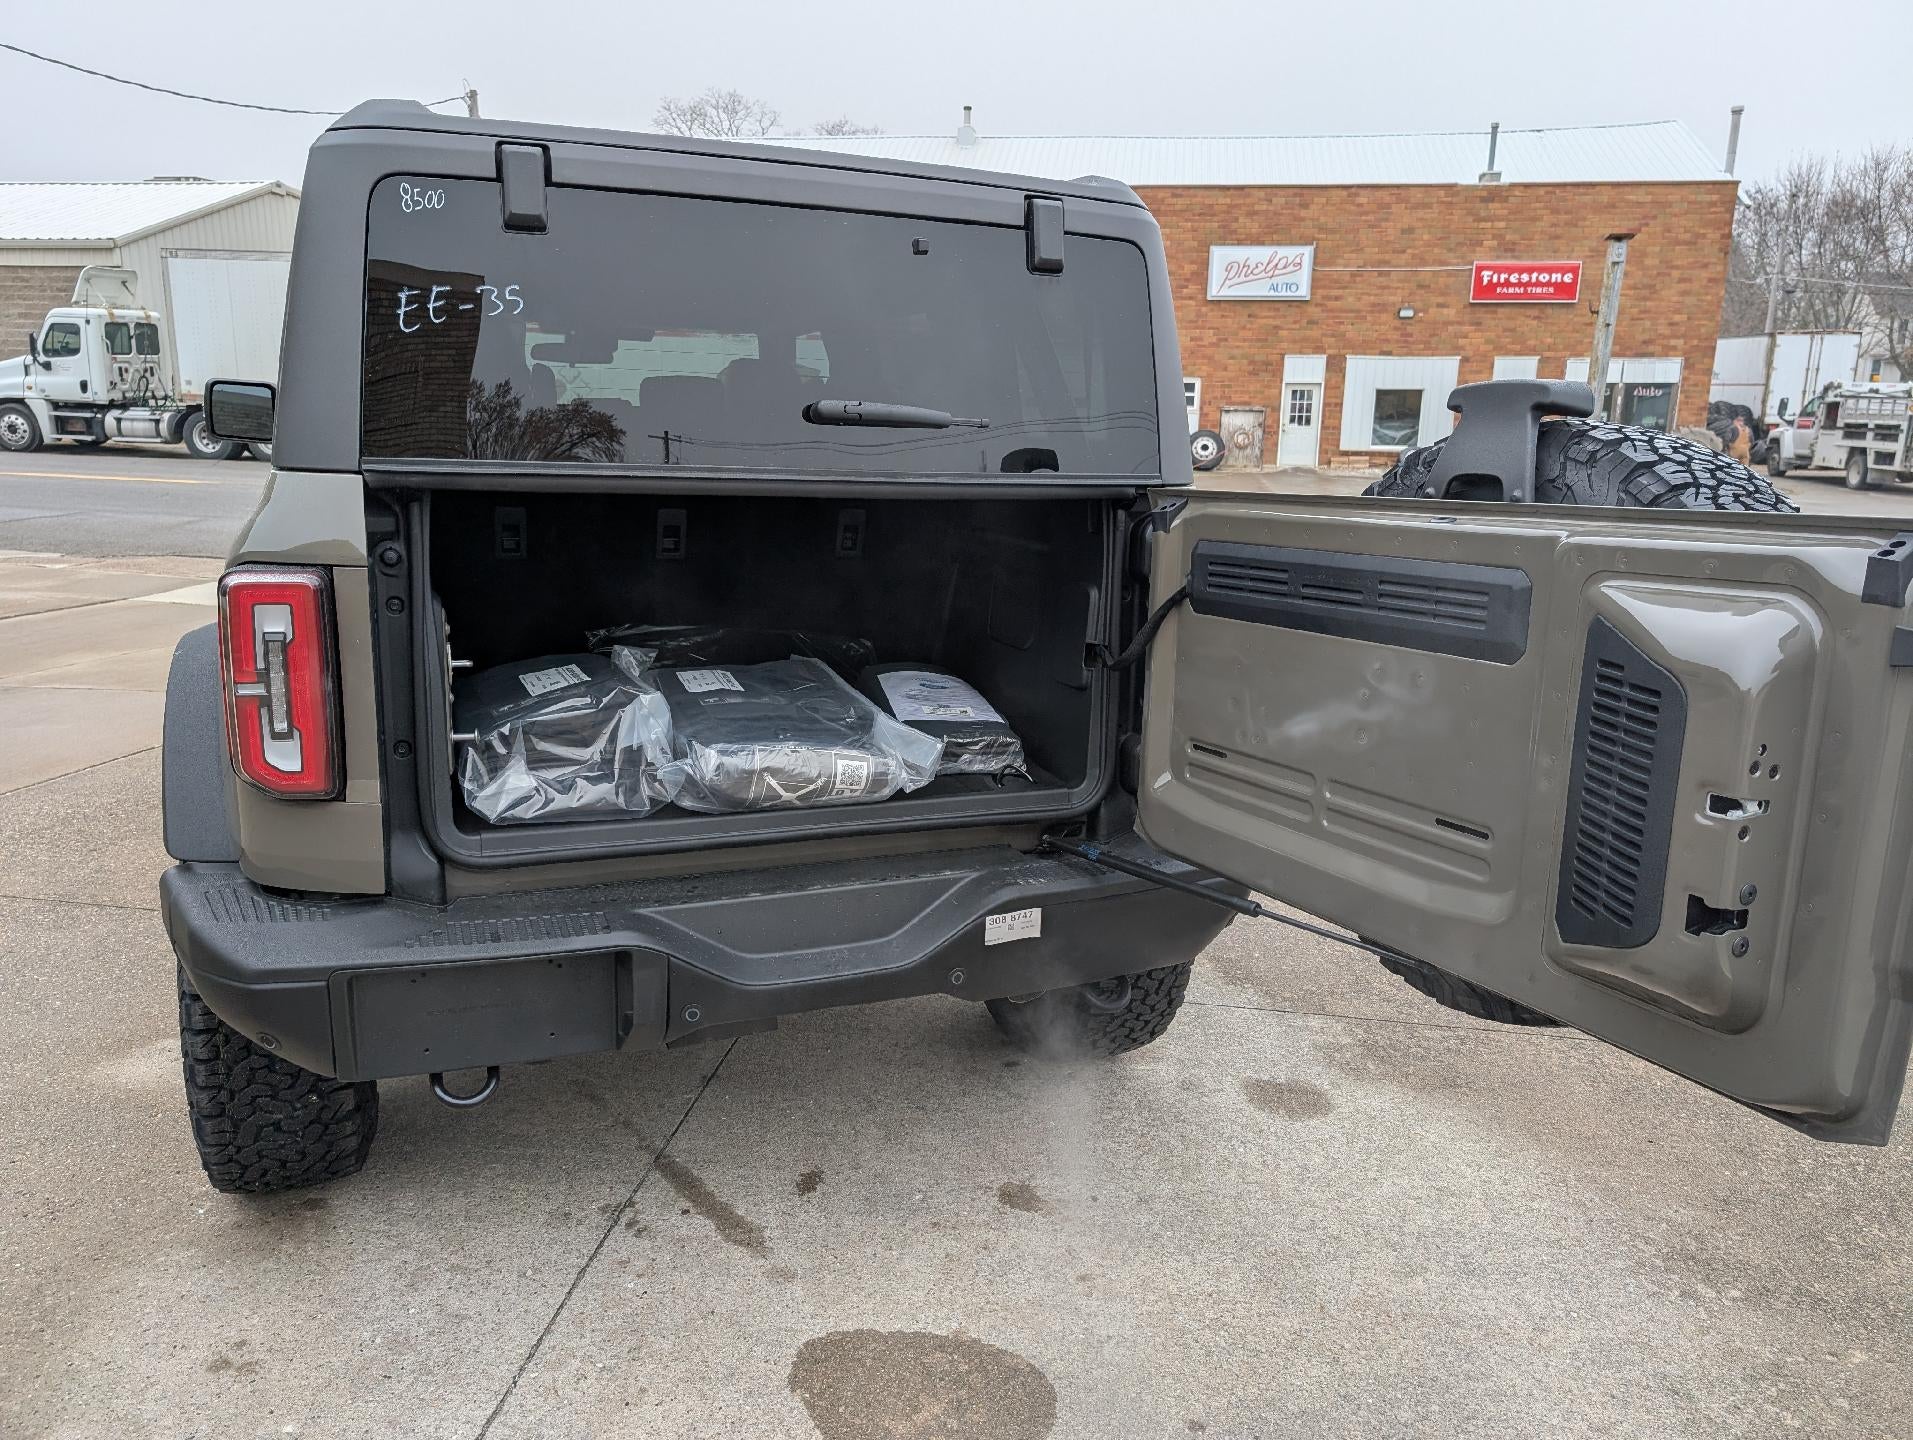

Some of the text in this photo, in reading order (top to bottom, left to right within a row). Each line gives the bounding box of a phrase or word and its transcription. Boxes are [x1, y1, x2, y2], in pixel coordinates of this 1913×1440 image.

[400, 182, 445, 212] 8500
[1217, 250, 1305, 294] Phelps
[1480, 270, 1575, 286] Firestone
[1267, 282, 1300, 294] AUTO
[1495, 286, 1555, 294] FARM TIRES
[988, 915, 1007, 926] 308
